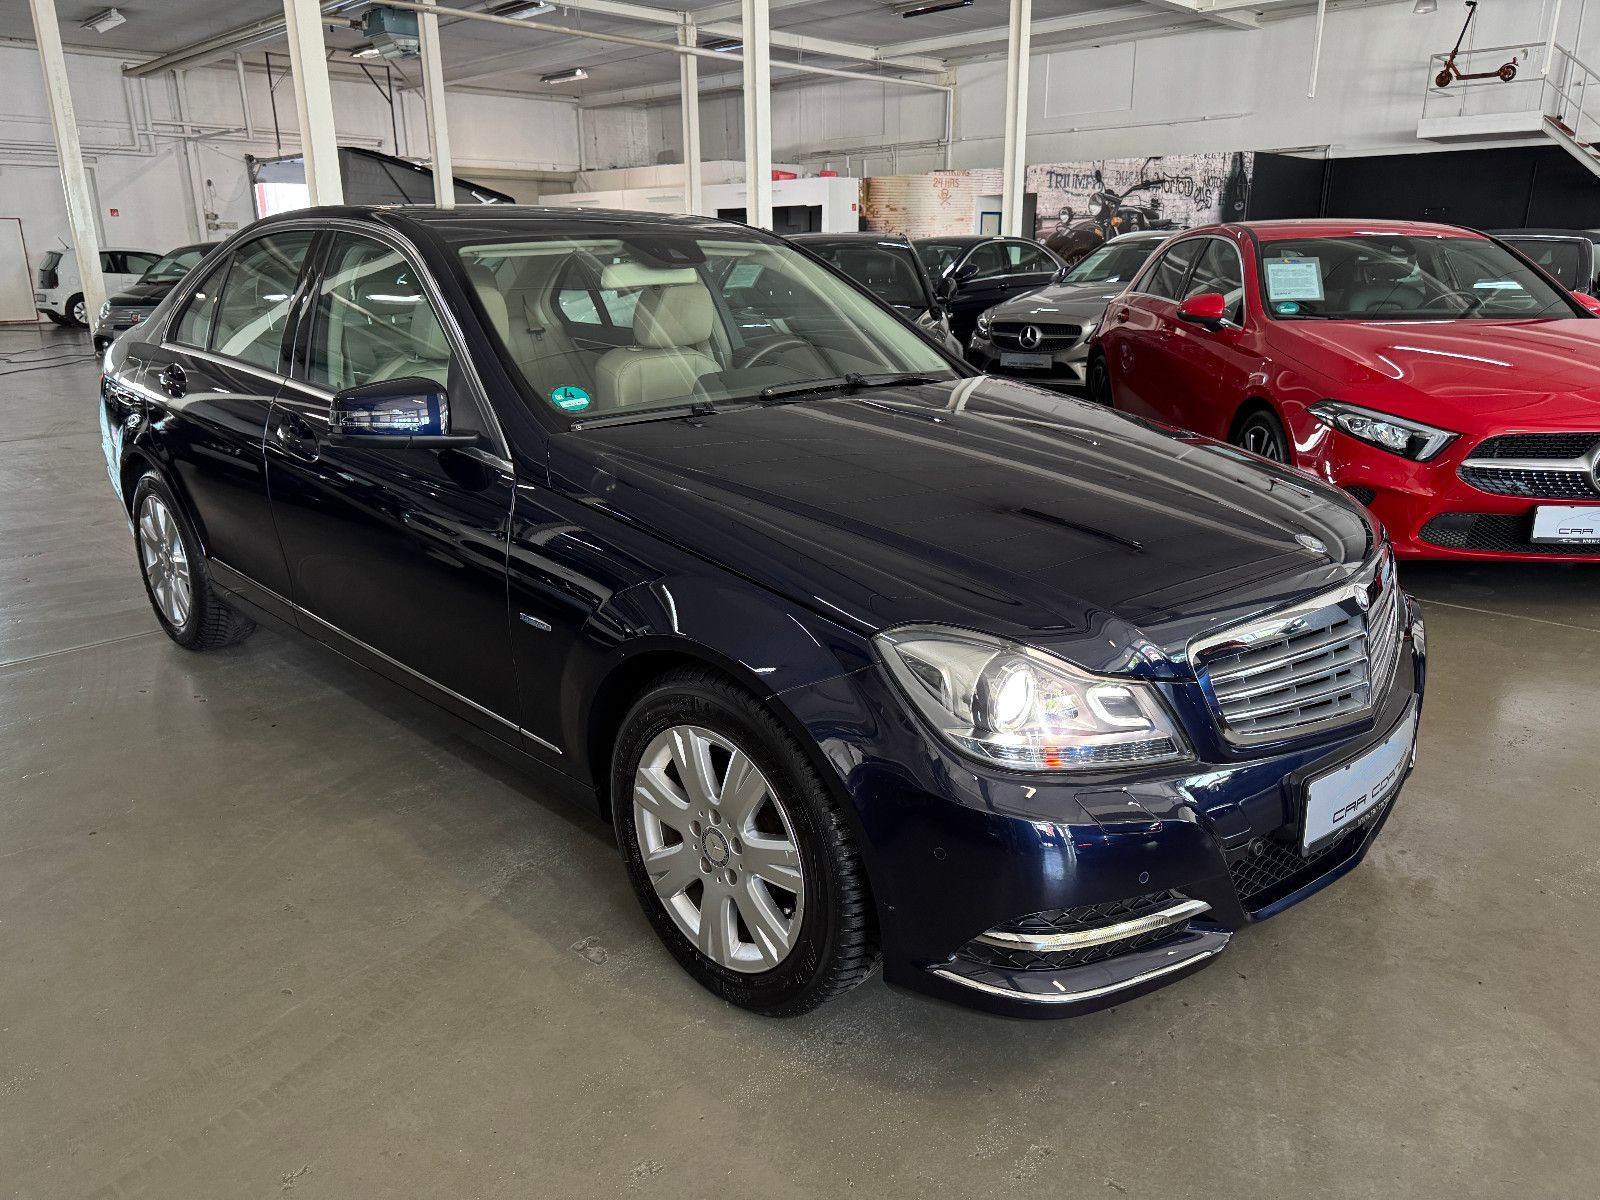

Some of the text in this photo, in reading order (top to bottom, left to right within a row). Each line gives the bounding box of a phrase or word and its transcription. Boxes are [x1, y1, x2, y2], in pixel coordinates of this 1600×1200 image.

[933, 177, 943, 188] 24
[564, 388, 575, 398] 4
[1333, 794, 1368, 824] CAR
